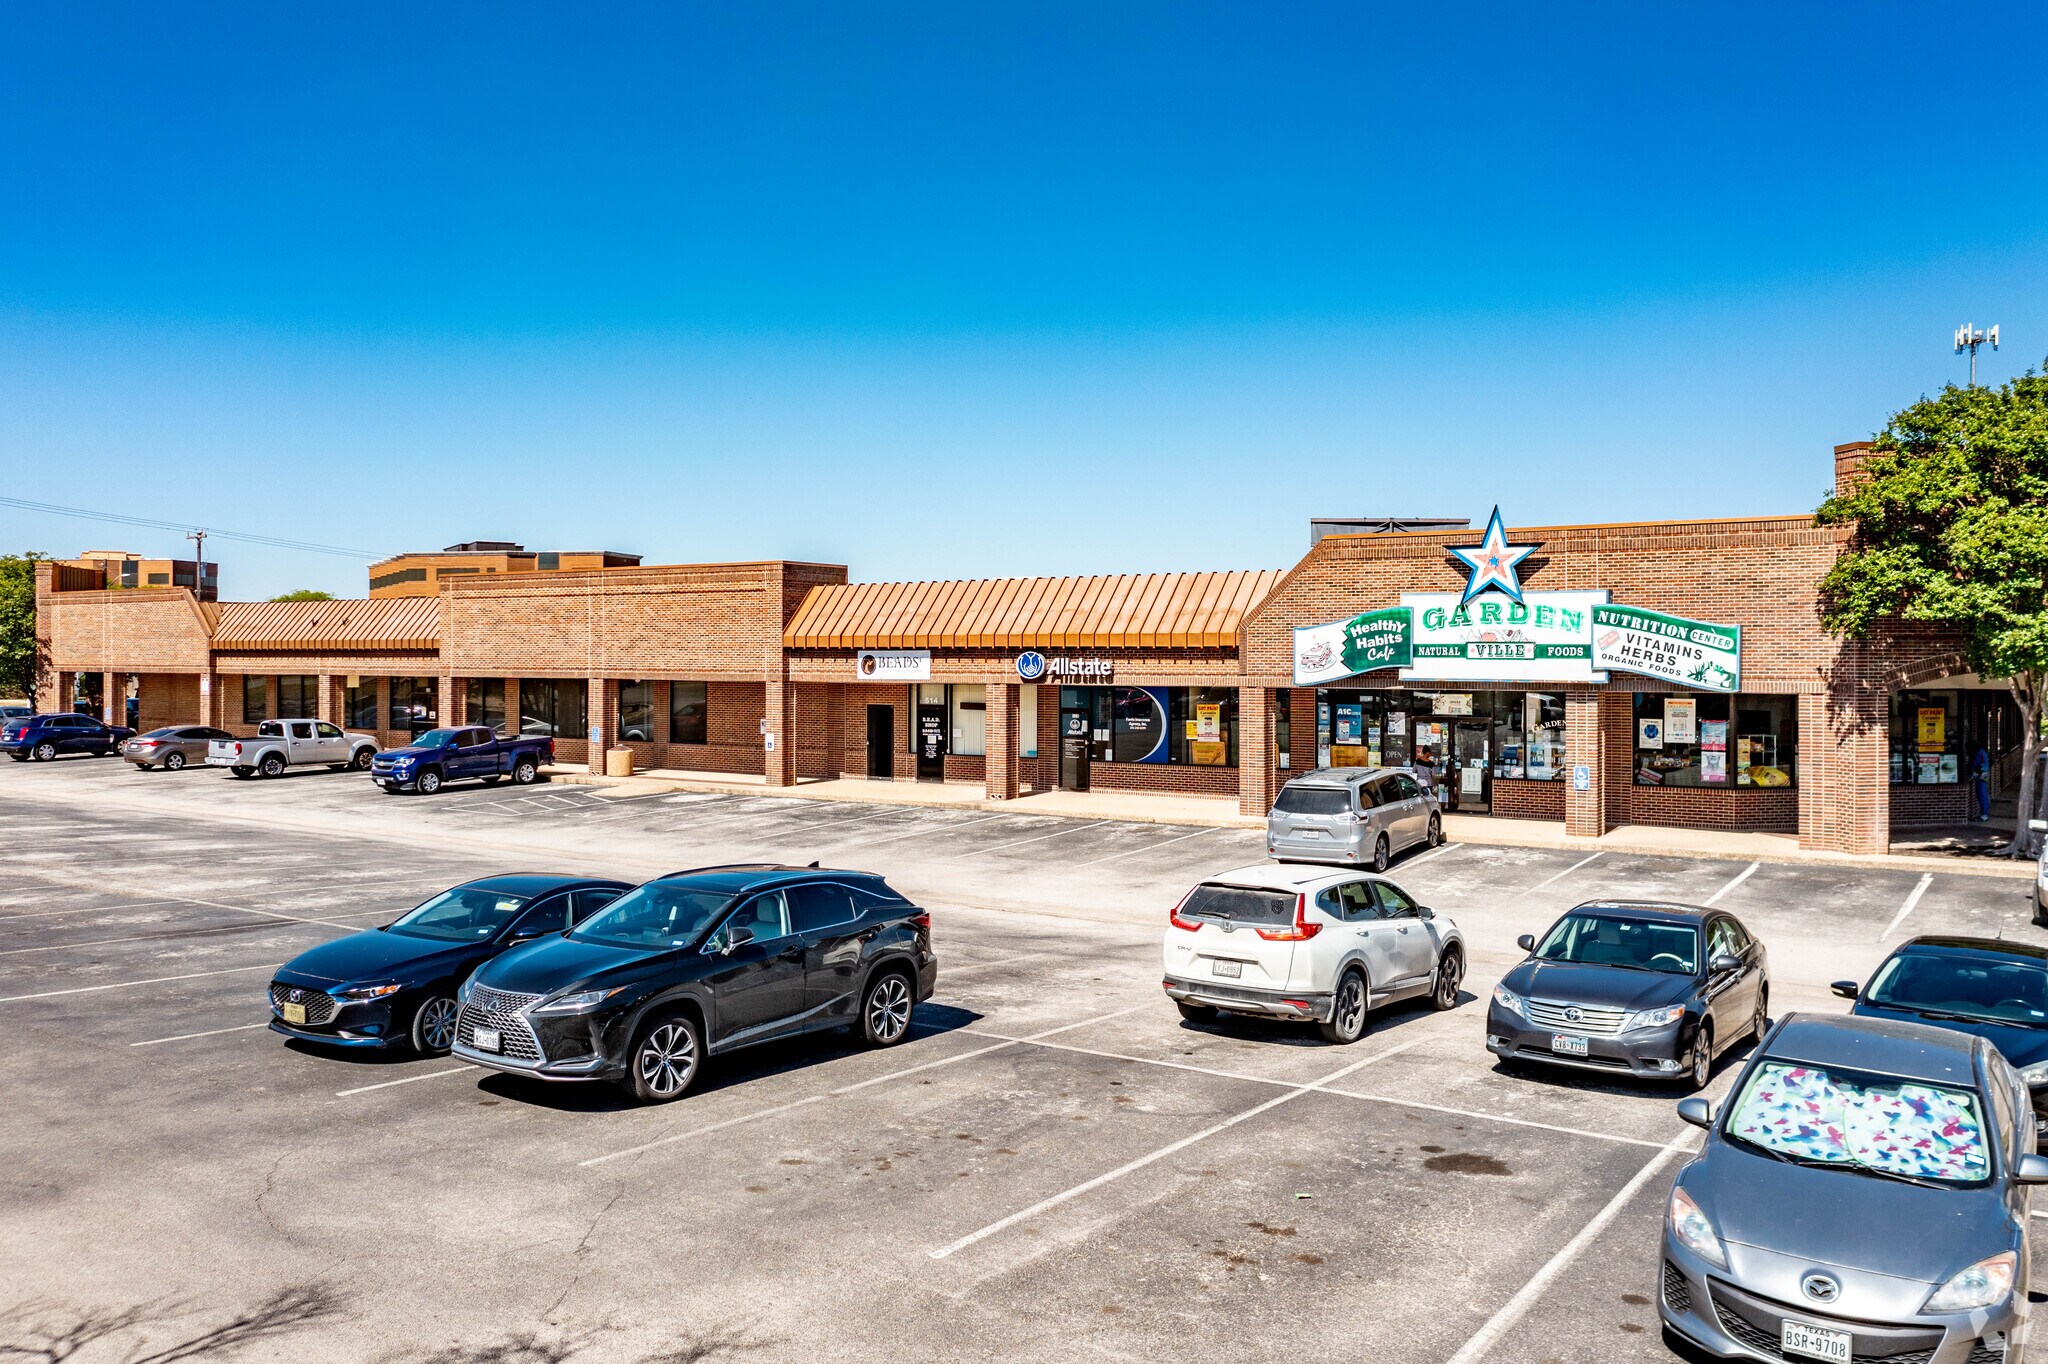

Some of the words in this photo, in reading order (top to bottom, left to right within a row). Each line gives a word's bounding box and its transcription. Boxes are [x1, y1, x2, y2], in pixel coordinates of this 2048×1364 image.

[1422, 602, 1585, 633] GARDEN
[1597, 610, 1689, 640] NUTRITION
[1691, 631, 1731, 648] CENTER
[1356, 633, 1403, 650] Habits
[1418, 645, 1461, 657] NATURAL
[1475, 644, 1526, 658] VILLE
[1547, 646, 1584, 657] FOODS
[1626, 632, 1703, 660] VITAMINS
[1367, 646, 1395, 661] Cafe
[1620, 645, 1677, 667] HERBS
[1046, 657, 1113, 676] Allstate
[1601, 653, 1644, 668] ORGANIC
[1648, 662, 1682, 677] FOODS
[1804, 1325, 1830, 1337] TEXAS
